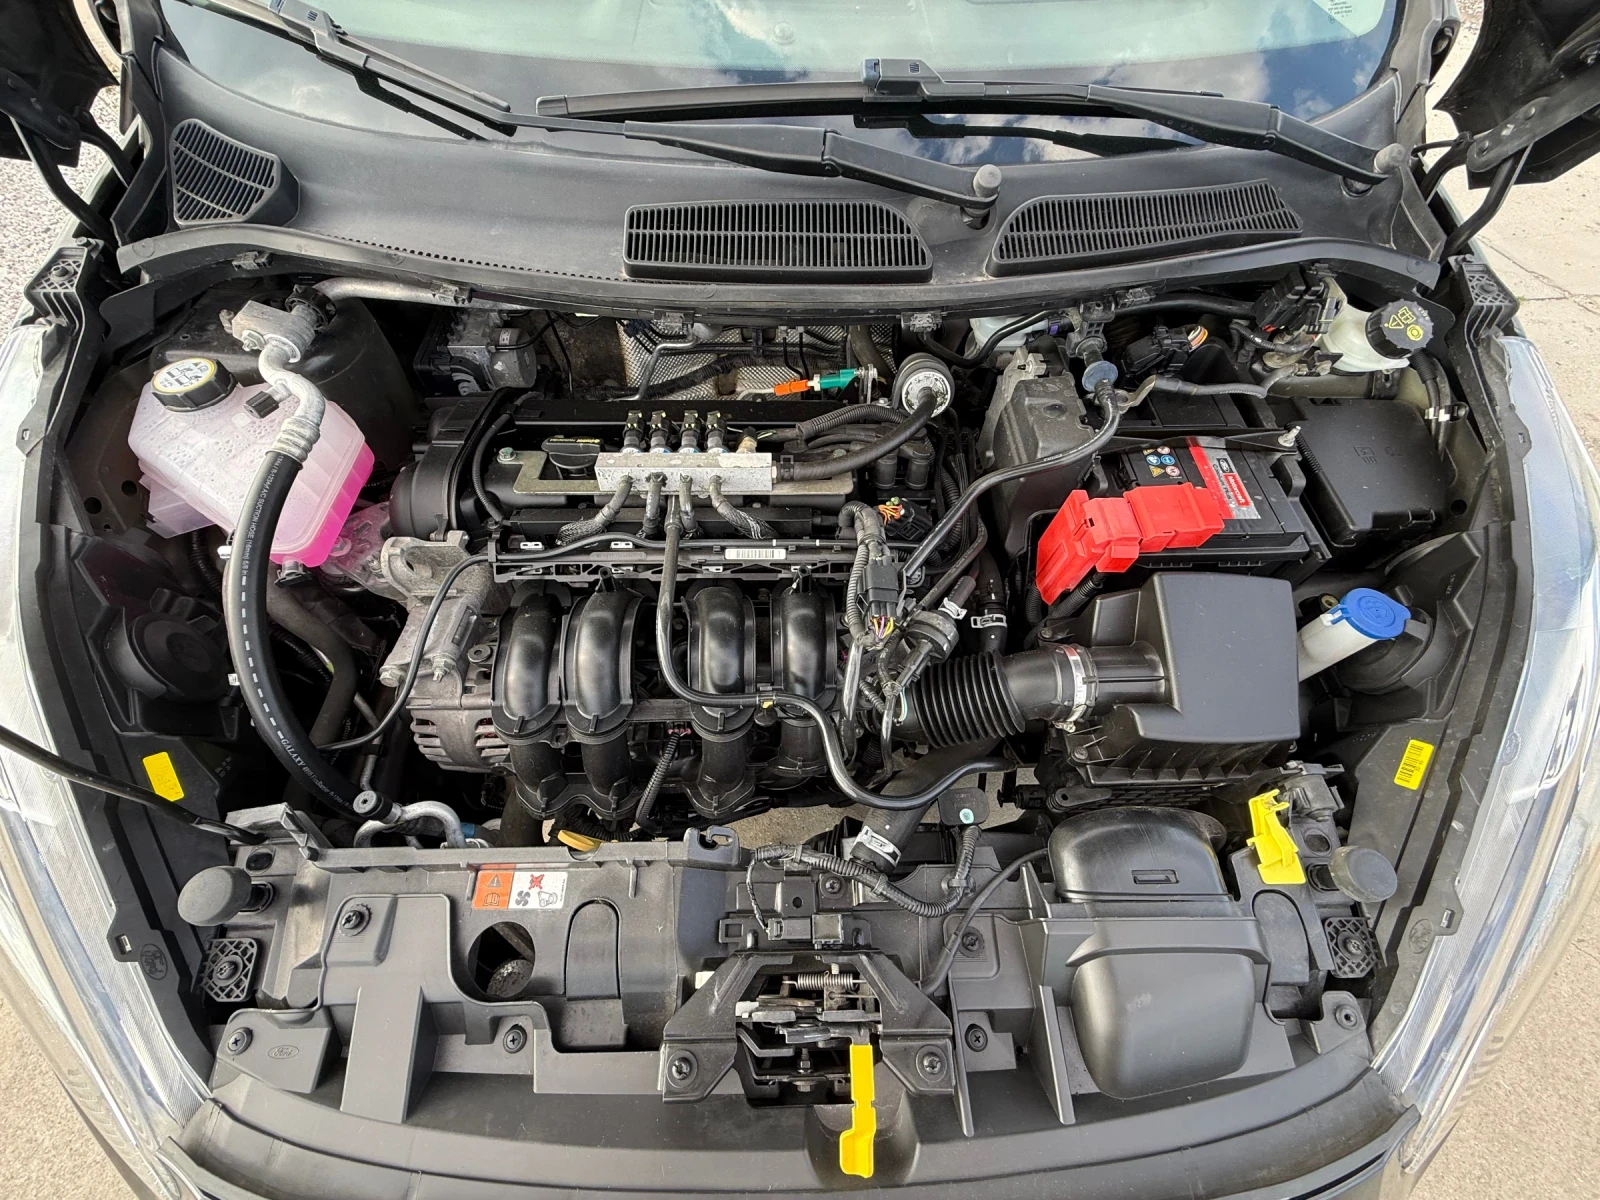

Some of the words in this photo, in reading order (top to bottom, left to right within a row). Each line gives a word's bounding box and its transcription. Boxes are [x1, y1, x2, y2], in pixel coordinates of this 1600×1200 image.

[1228, 476, 1245, 504] Motorcraft
[252, 498, 265, 523] SUCTION
[248, 523, 257, 539] HOSE
[281, 739, 305, 766] GALAXY
